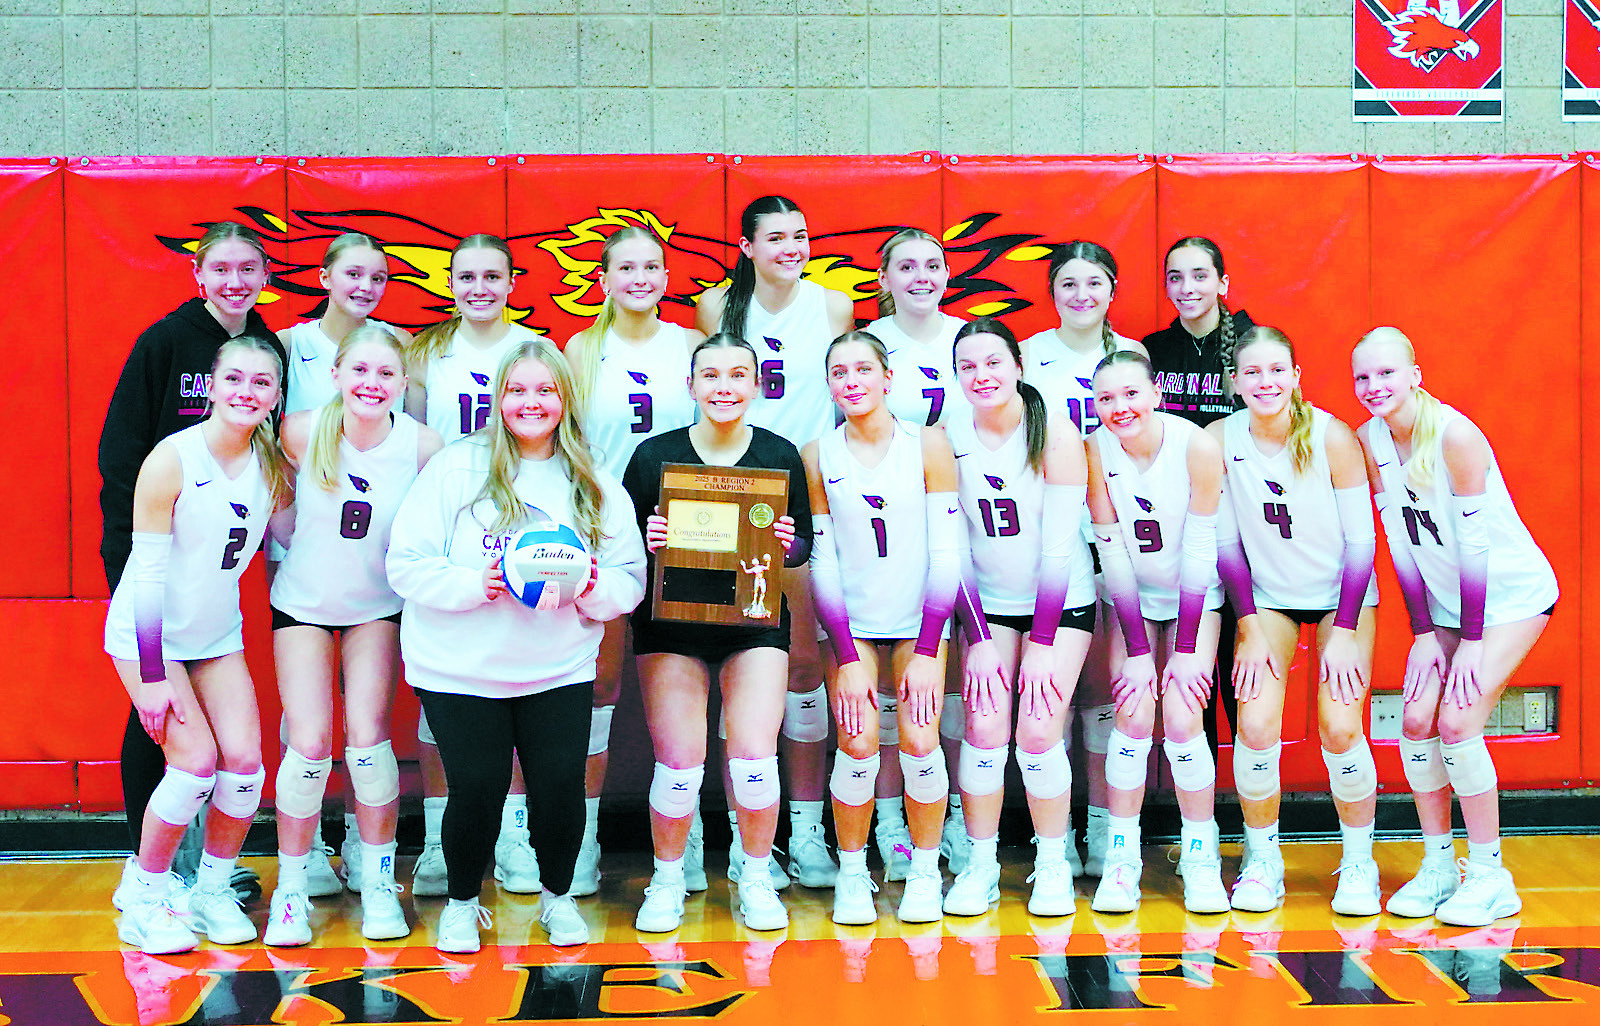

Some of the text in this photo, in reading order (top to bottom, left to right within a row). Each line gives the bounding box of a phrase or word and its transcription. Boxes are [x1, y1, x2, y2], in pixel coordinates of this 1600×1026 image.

[761, 359, 785, 399] 6
[1154, 371, 1223, 395] ARDINAL
[458, 393, 492, 434] 12
[628, 393, 653, 434] 3
[921, 387, 945, 427] 7
[1067, 397, 1103, 435] 15
[704, 483, 745, 491] CHAMPION
[721, 477, 750, 486] REGION
[339, 500, 373, 540] 8
[673, 528, 731, 539] Congratulations
[870, 517, 888, 558] 1
[977, 498, 1021, 538] 13
[1133, 519, 1164, 554] 9
[1263, 502, 1293, 539] 4
[1401, 505, 1444, 546] 14
[220, 527, 249, 570] 2
[532, 548, 575, 560] Baden
